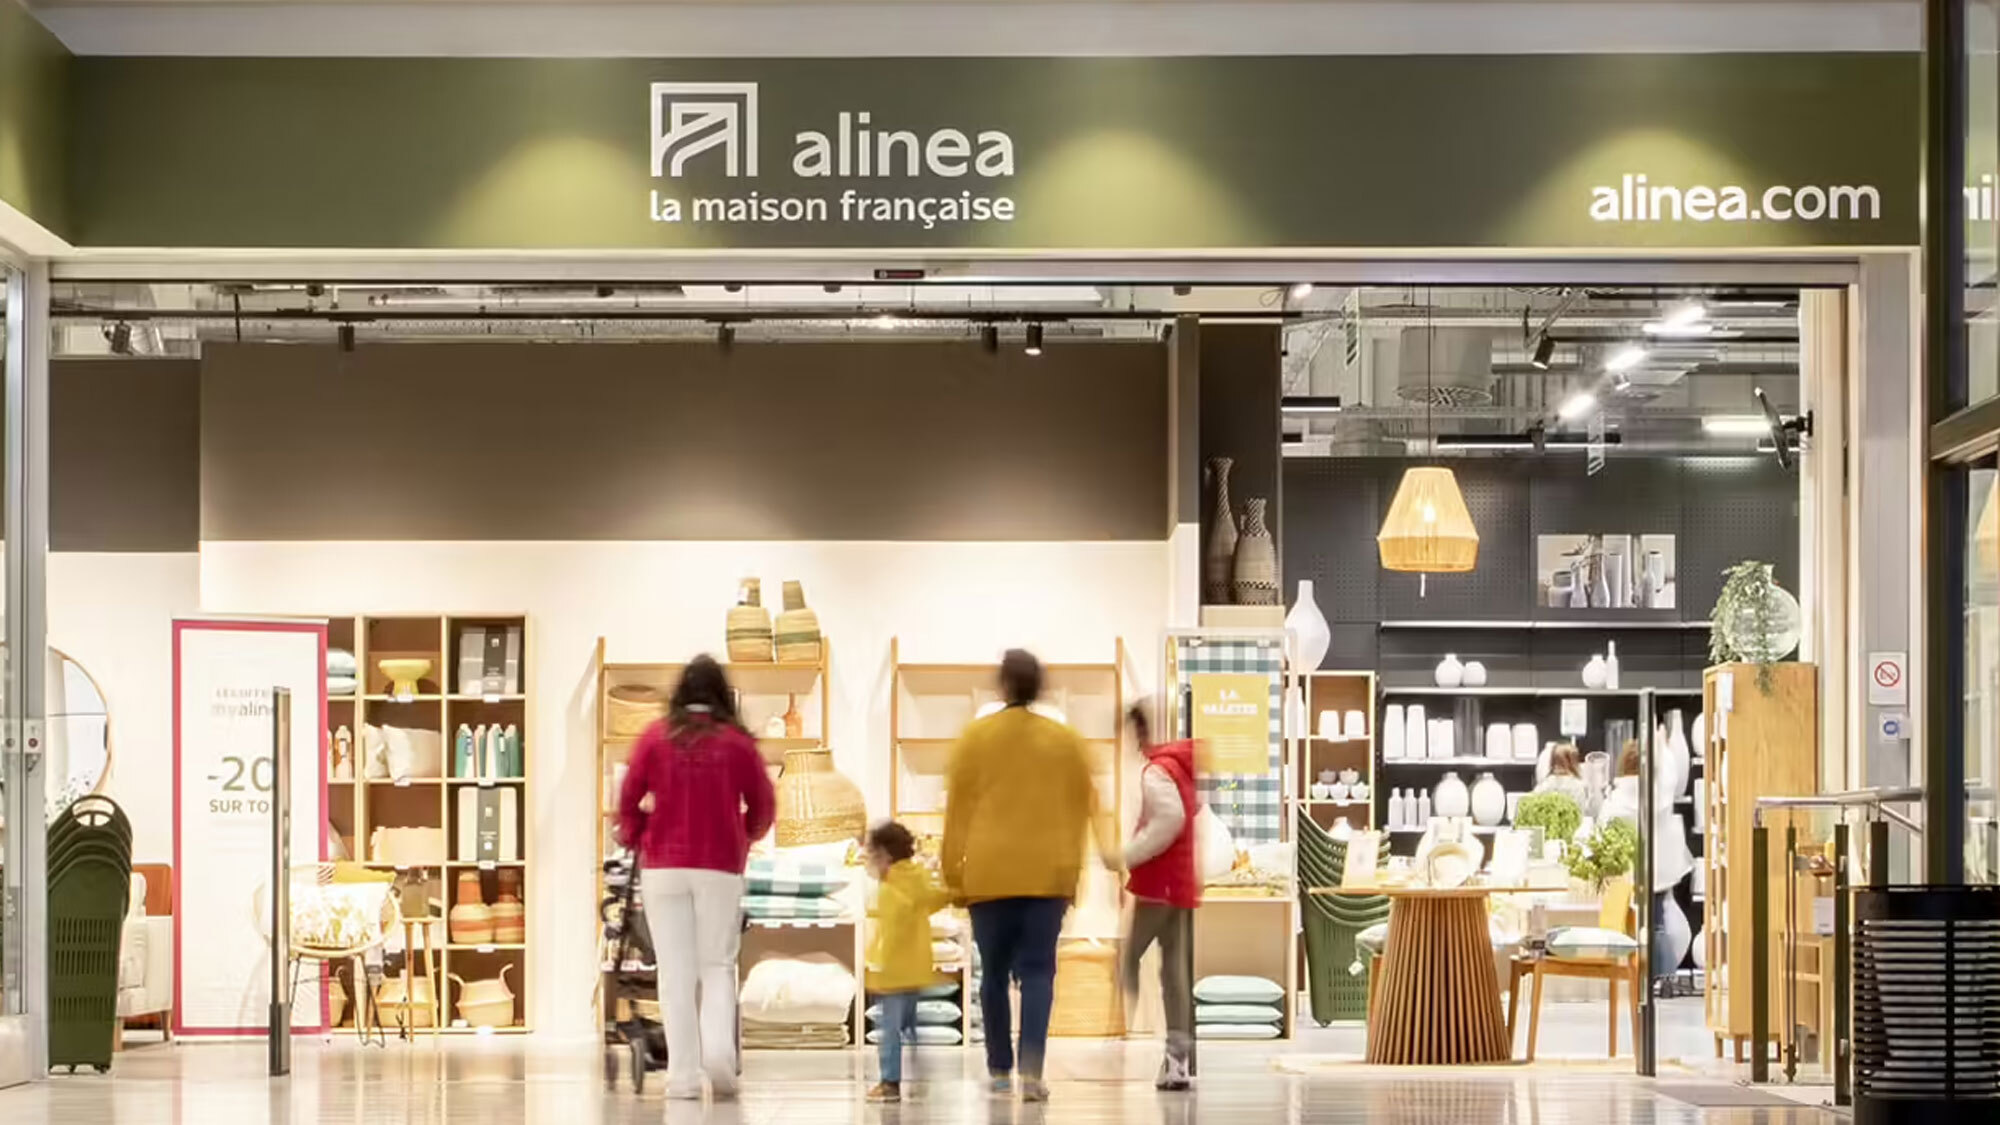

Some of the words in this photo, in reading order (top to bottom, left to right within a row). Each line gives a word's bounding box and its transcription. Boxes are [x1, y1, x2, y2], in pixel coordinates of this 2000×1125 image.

[792, 111, 1014, 177] alinea
[650, 189, 681, 221] la
[692, 190, 827, 221] maison
[839, 189, 1014, 229] française
[1589, 173, 1881, 221] alinea.com
[209, 799, 241, 813] SUR
